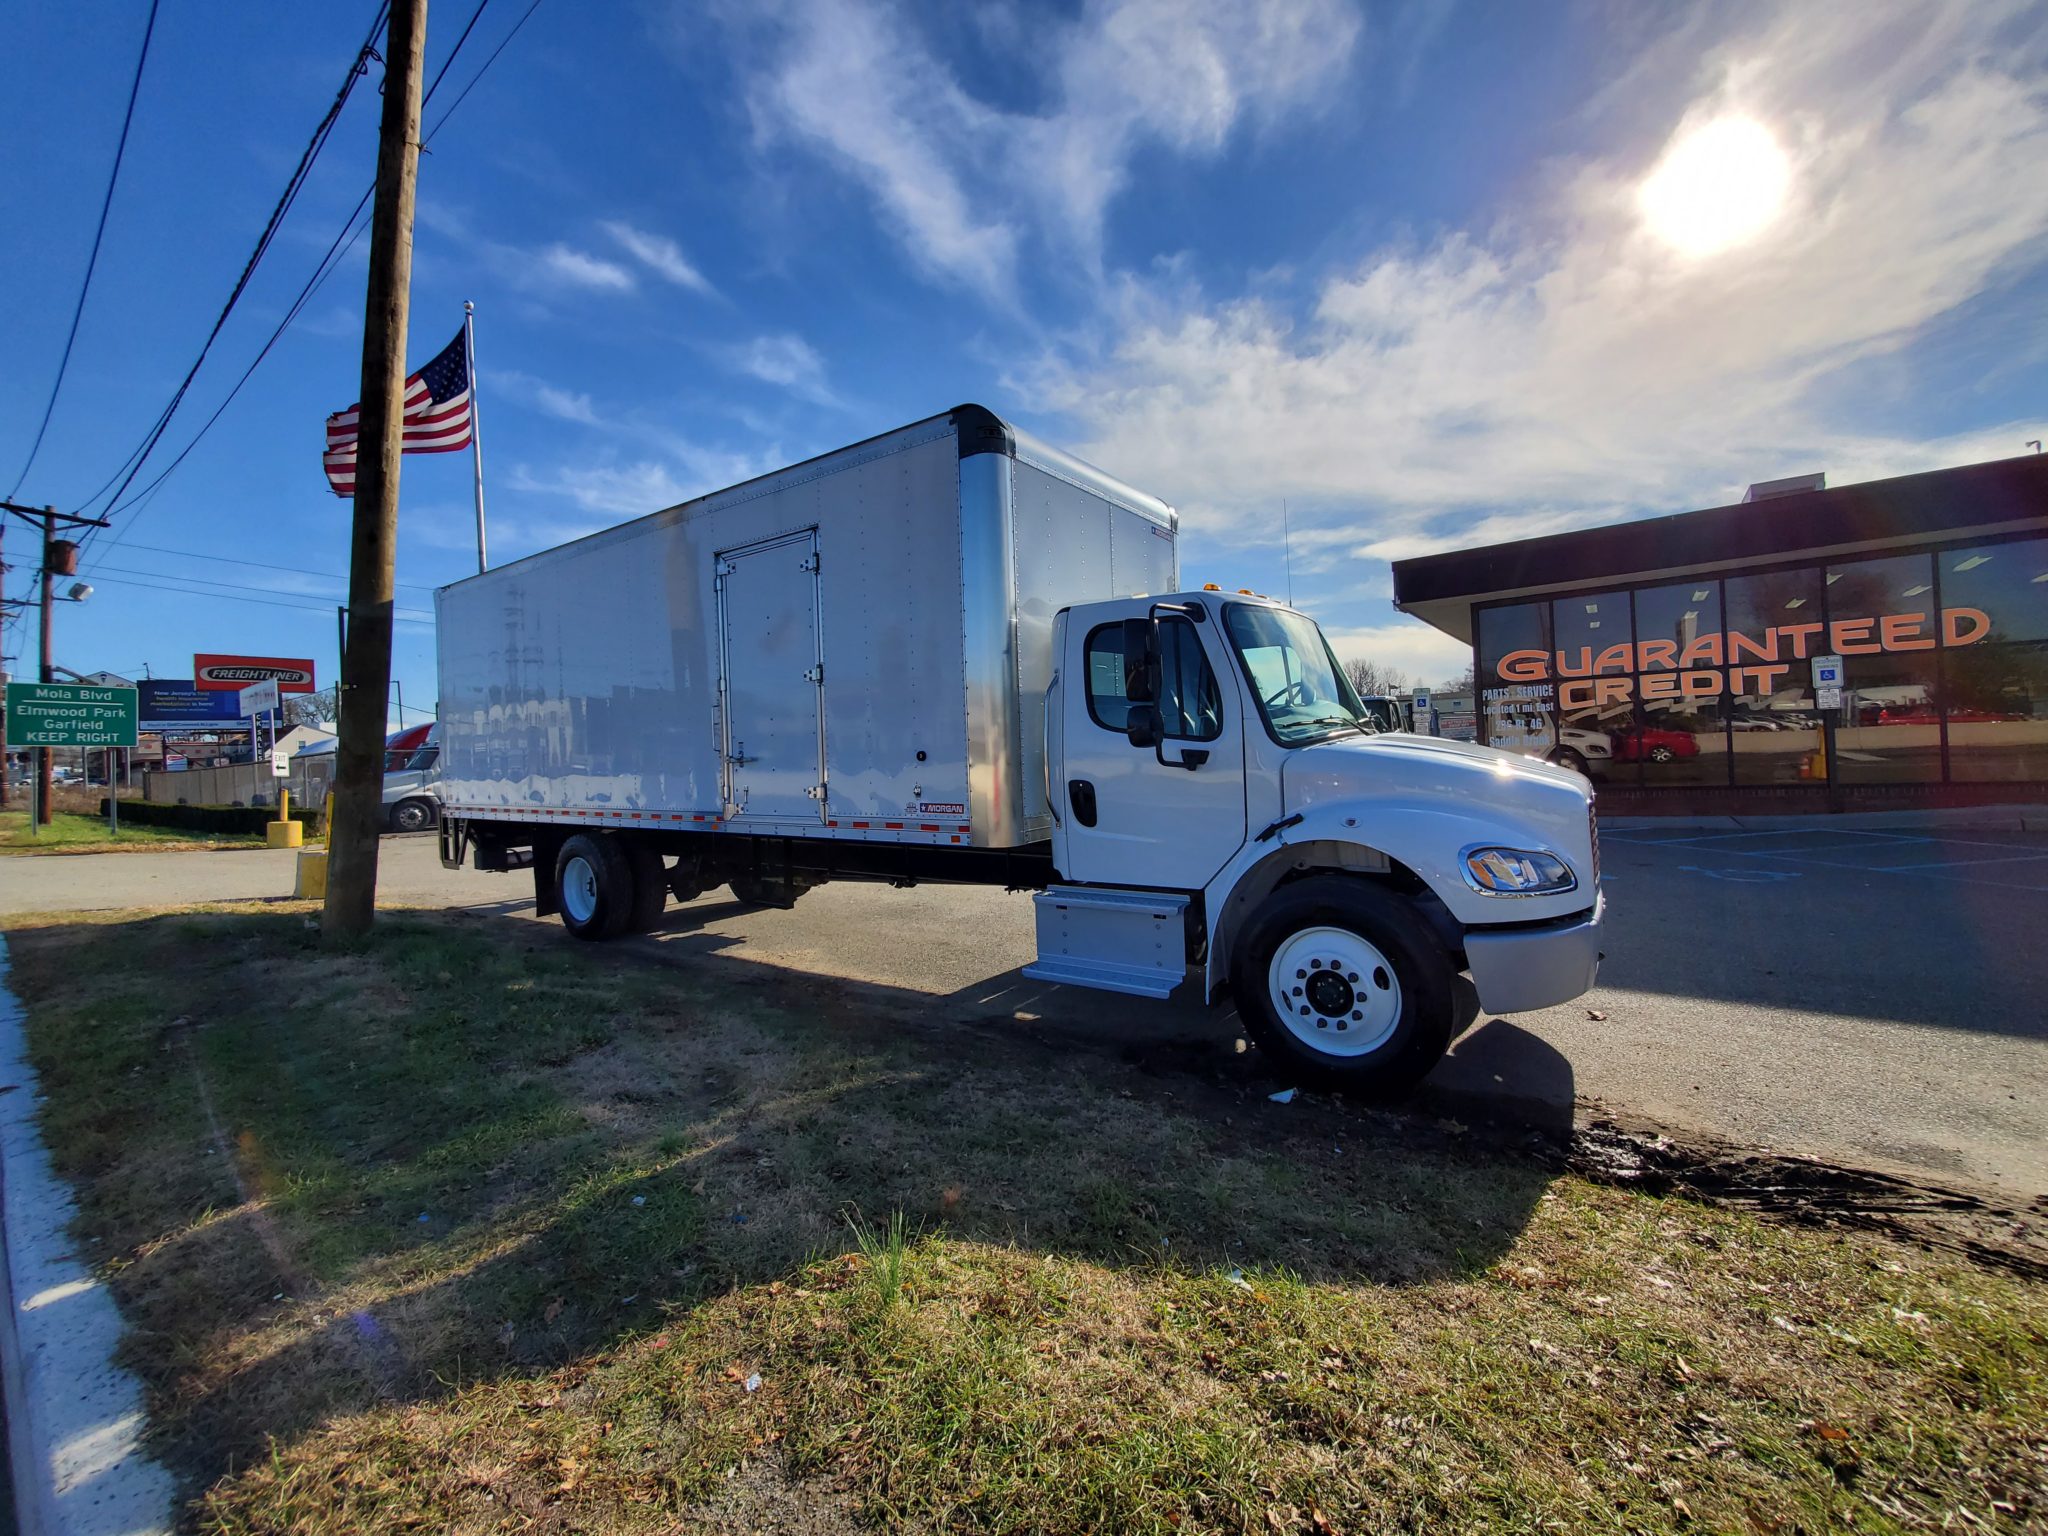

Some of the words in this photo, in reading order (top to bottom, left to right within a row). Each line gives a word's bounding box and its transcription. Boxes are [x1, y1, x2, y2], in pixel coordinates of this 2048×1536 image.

[1497, 607, 1991, 682] GUARANTEED
[212, 669, 300, 680] FREIGHTLINER
[1482, 688, 1509, 701] PARTS
[1517, 684, 1554, 698] SERVICE
[1558, 664, 1790, 711] CREDIT
[36, 689, 72, 699] Mola
[80, 690, 112, 701] Blvd
[17, 705, 87, 717] Elmwood
[94, 708, 127, 718] Park
[1483, 704, 1514, 715] Located
[1536, 702, 1554, 712] East
[44, 719, 104, 730] Garfield
[27, 731, 69, 742] KEEP
[77, 733, 119, 743] RIGHT
[927, 804, 963, 813] MORGAN
